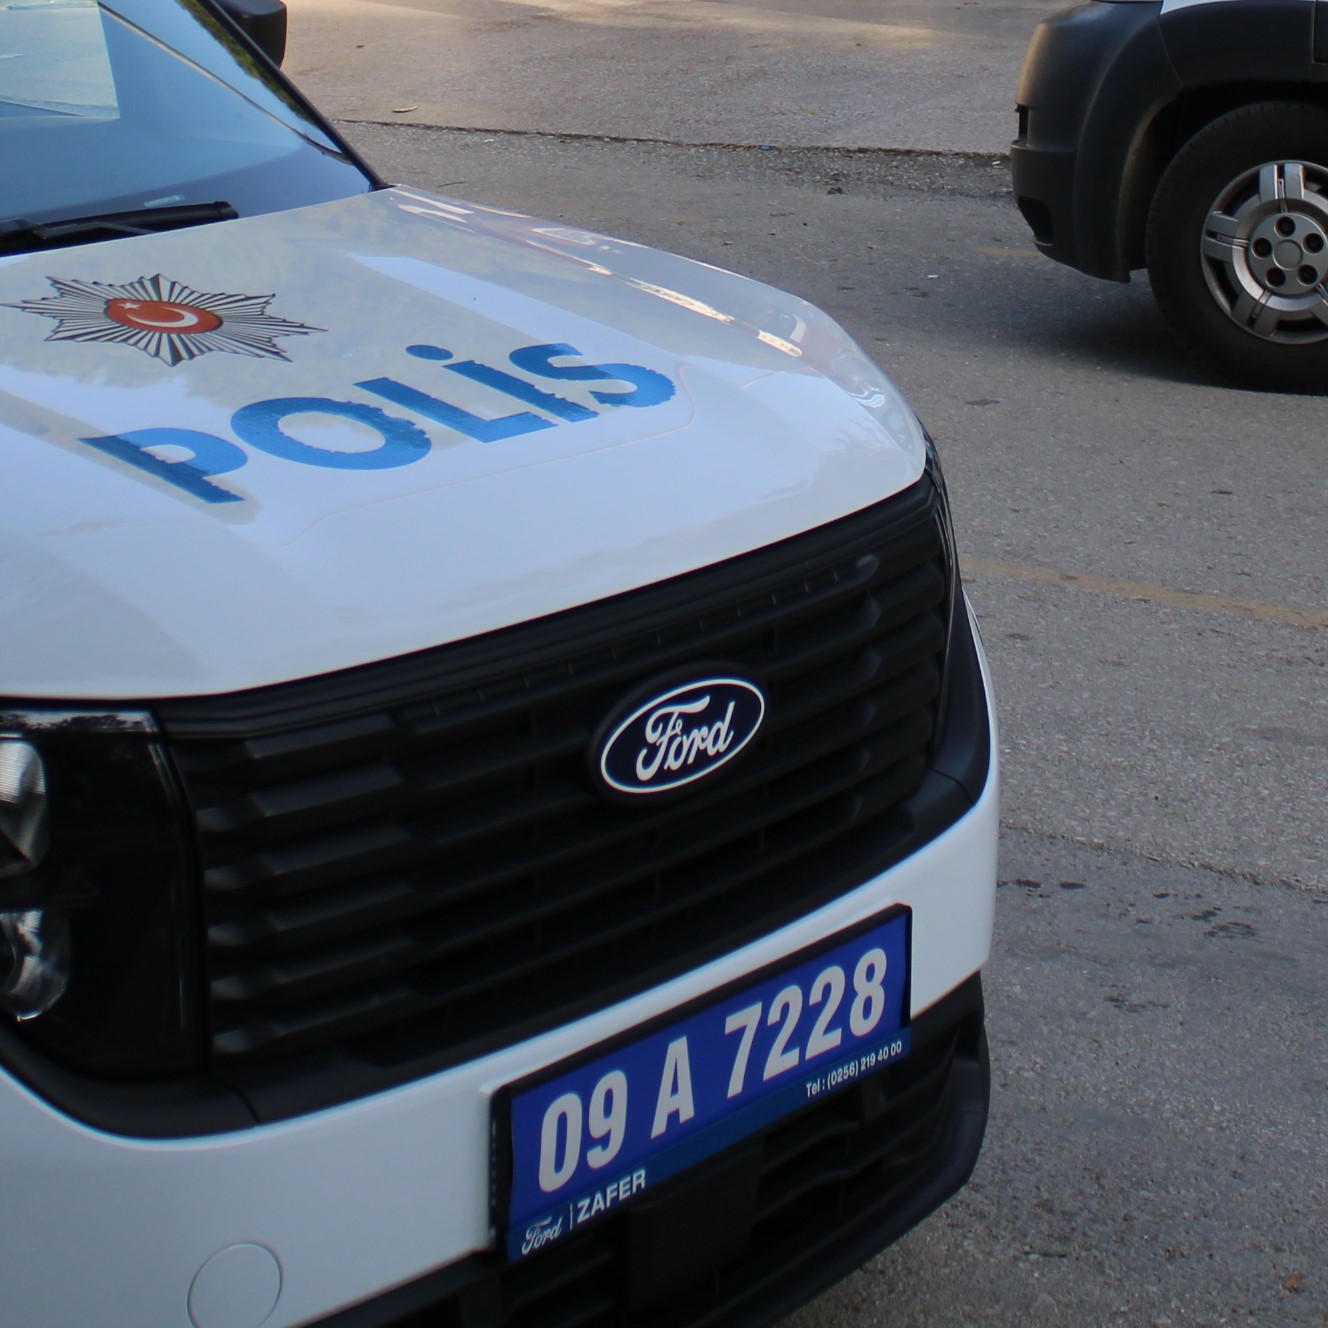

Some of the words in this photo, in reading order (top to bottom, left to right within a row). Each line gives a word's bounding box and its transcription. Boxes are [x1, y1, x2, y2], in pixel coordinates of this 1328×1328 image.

[77, 343, 677, 504] POLİS
[636, 694, 736, 782] Ford
[538, 1069, 628, 1193] 09
[650, 1035, 696, 1140] A
[724, 947, 888, 1100] 7228
[806, 1078, 821, 1099] Tel
[827, 1060, 860, 1091] (0256)
[860, 1052, 876, 1072] 219
[877, 1045, 889, 1062] 40
[890, 1040, 903, 1056] 00
[521, 1215, 564, 1255] Ford
[577, 1168, 647, 1225] ZAFER
